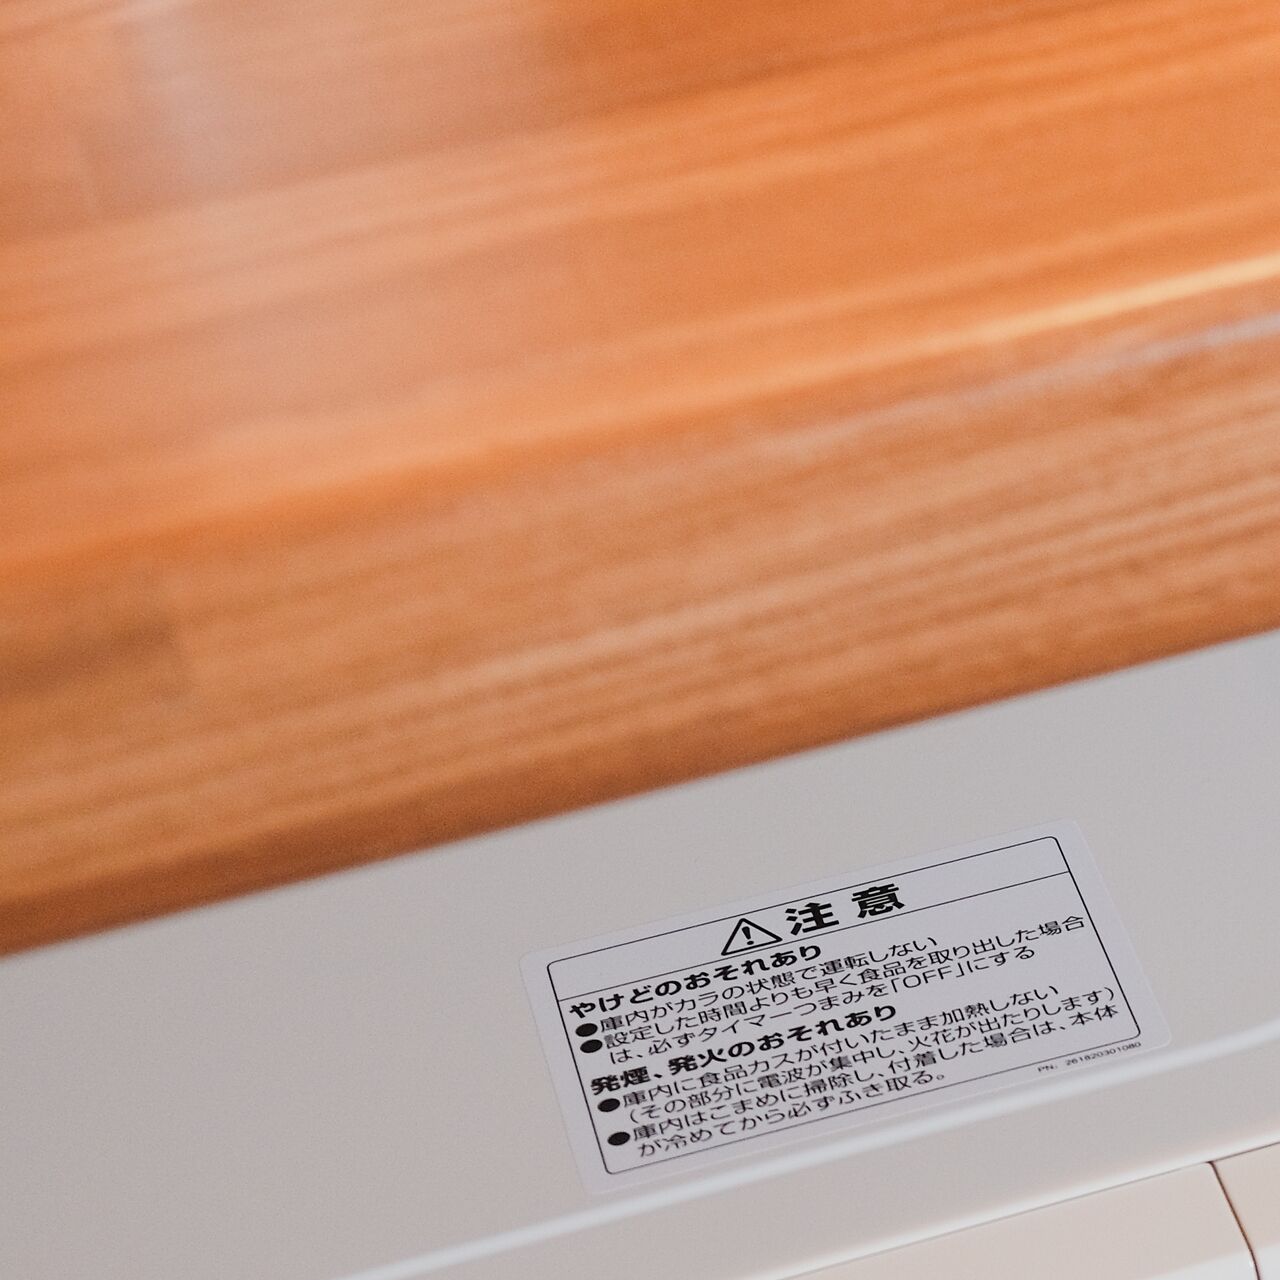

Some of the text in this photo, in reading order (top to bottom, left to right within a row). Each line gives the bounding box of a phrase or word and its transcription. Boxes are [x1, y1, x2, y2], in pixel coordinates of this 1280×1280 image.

[785, 883, 905, 935] 注意
[569, 946, 821, 1018] やけどのおそれあり
[600, 937, 937, 1032] 庫内がカラの状態で運転しない
[604, 916, 1084, 1049] 設定した時間よりも早く食品を取り出した場合
[610, 946, 1034, 1064] は、必ずタイマーつまみを「OFF」にする
[591, 1006, 896, 1095] 発煙、発火のおそれあり
[623, 986, 1058, 1107] 庫内に食品カスが付いたまま加熱しない
[633, 1005, 1118, 1141] 庫内はこまめに掃除し、付着した場合は、本体
[639, 1071, 944, 1157] が冷めてから必ずふき取る。
